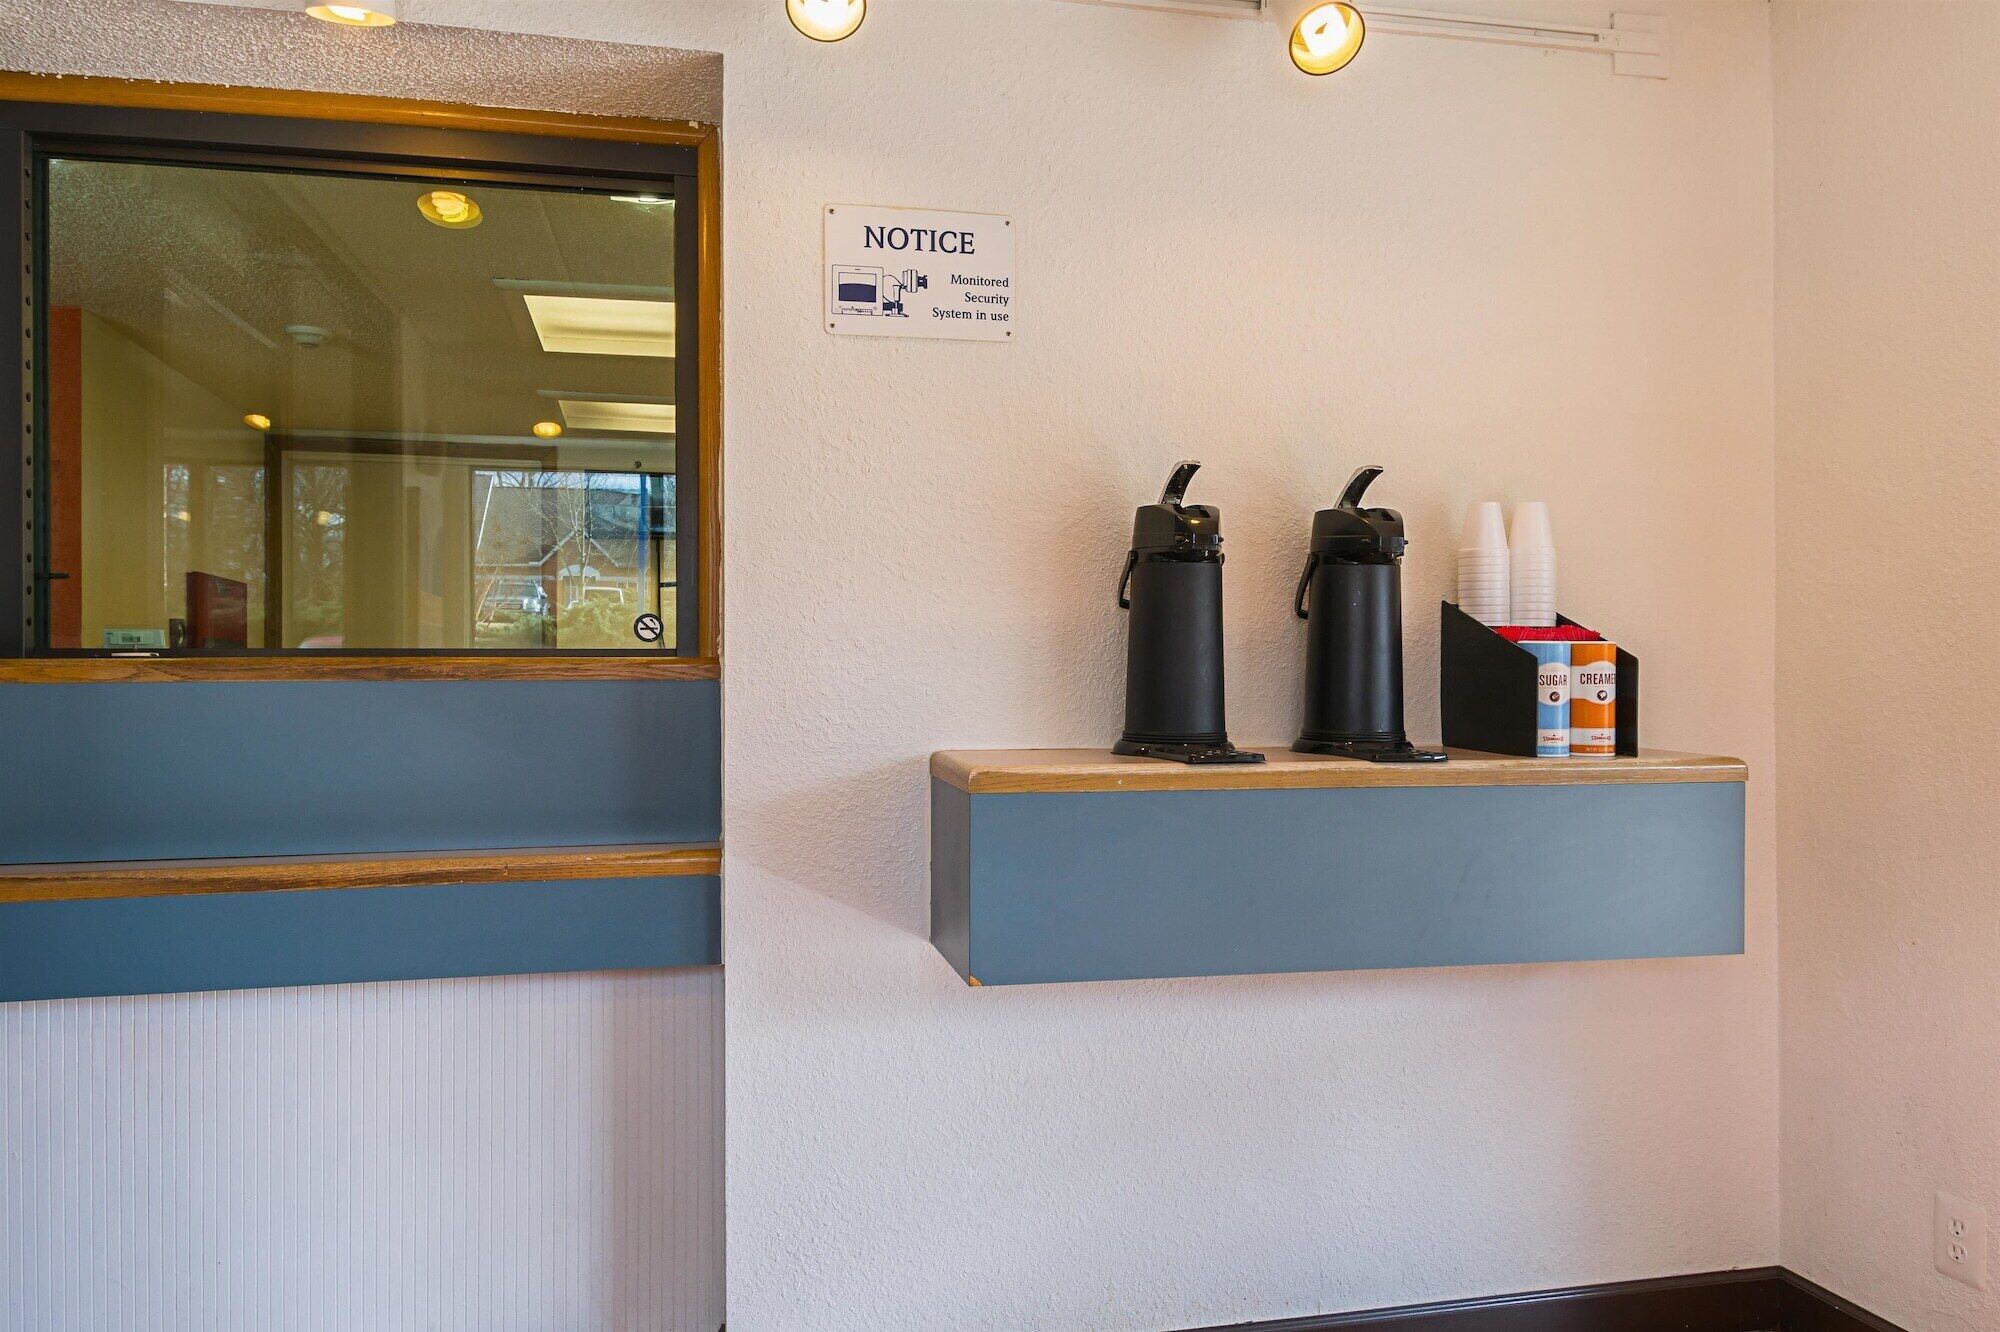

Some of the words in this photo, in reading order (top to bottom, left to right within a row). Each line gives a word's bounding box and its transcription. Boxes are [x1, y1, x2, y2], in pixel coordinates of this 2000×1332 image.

[863, 225, 976, 255] NOTICE
[950, 274, 1010, 288] Monitored
[964, 292, 1010, 307] Security
[932, 307, 973, 320] System
[976, 307, 987, 320] in
[990, 312, 1010, 322] use
[1539, 674, 1568, 686] SUGAR
